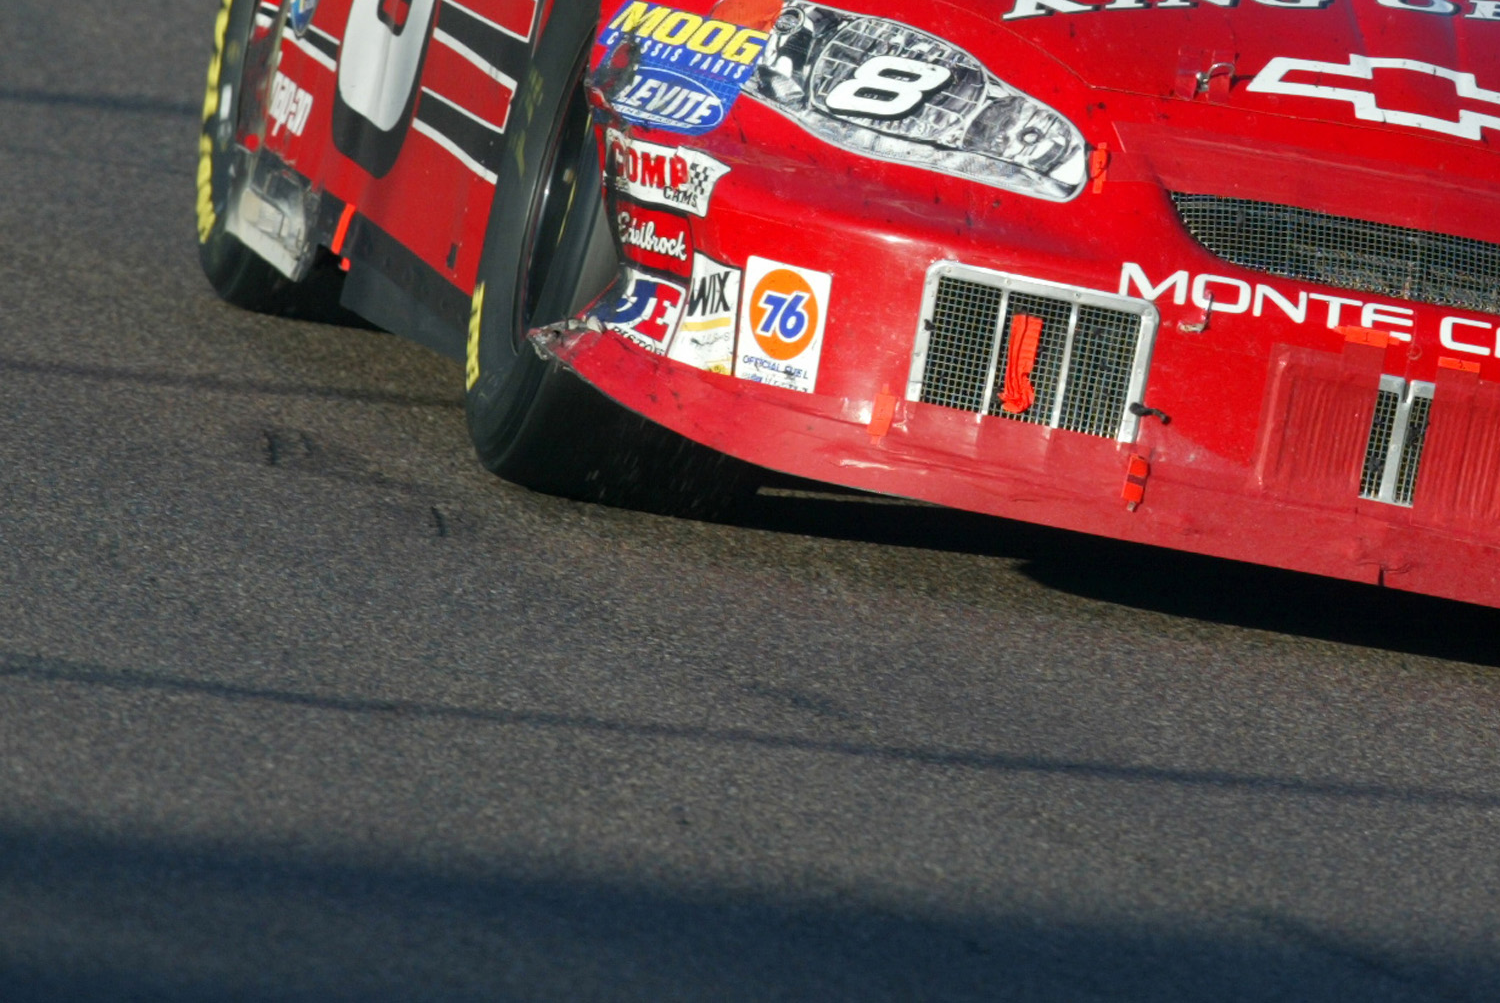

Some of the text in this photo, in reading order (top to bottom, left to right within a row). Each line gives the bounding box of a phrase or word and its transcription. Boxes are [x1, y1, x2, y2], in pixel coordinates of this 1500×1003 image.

[606, 31, 683, 63] CSSIS
[608, 0, 771, 66] MOOG
[688, 52, 748, 80] PARTS
[825, 55, 952, 119] 8
[613, 75, 722, 126] LEVITE
[663, 186, 700, 209] CAMS
[687, 270, 731, 318] WIX
[758, 292, 810, 341] 76
[1117, 261, 1414, 342] MONTE
[742, 355, 780, 372] OFFICIAL
